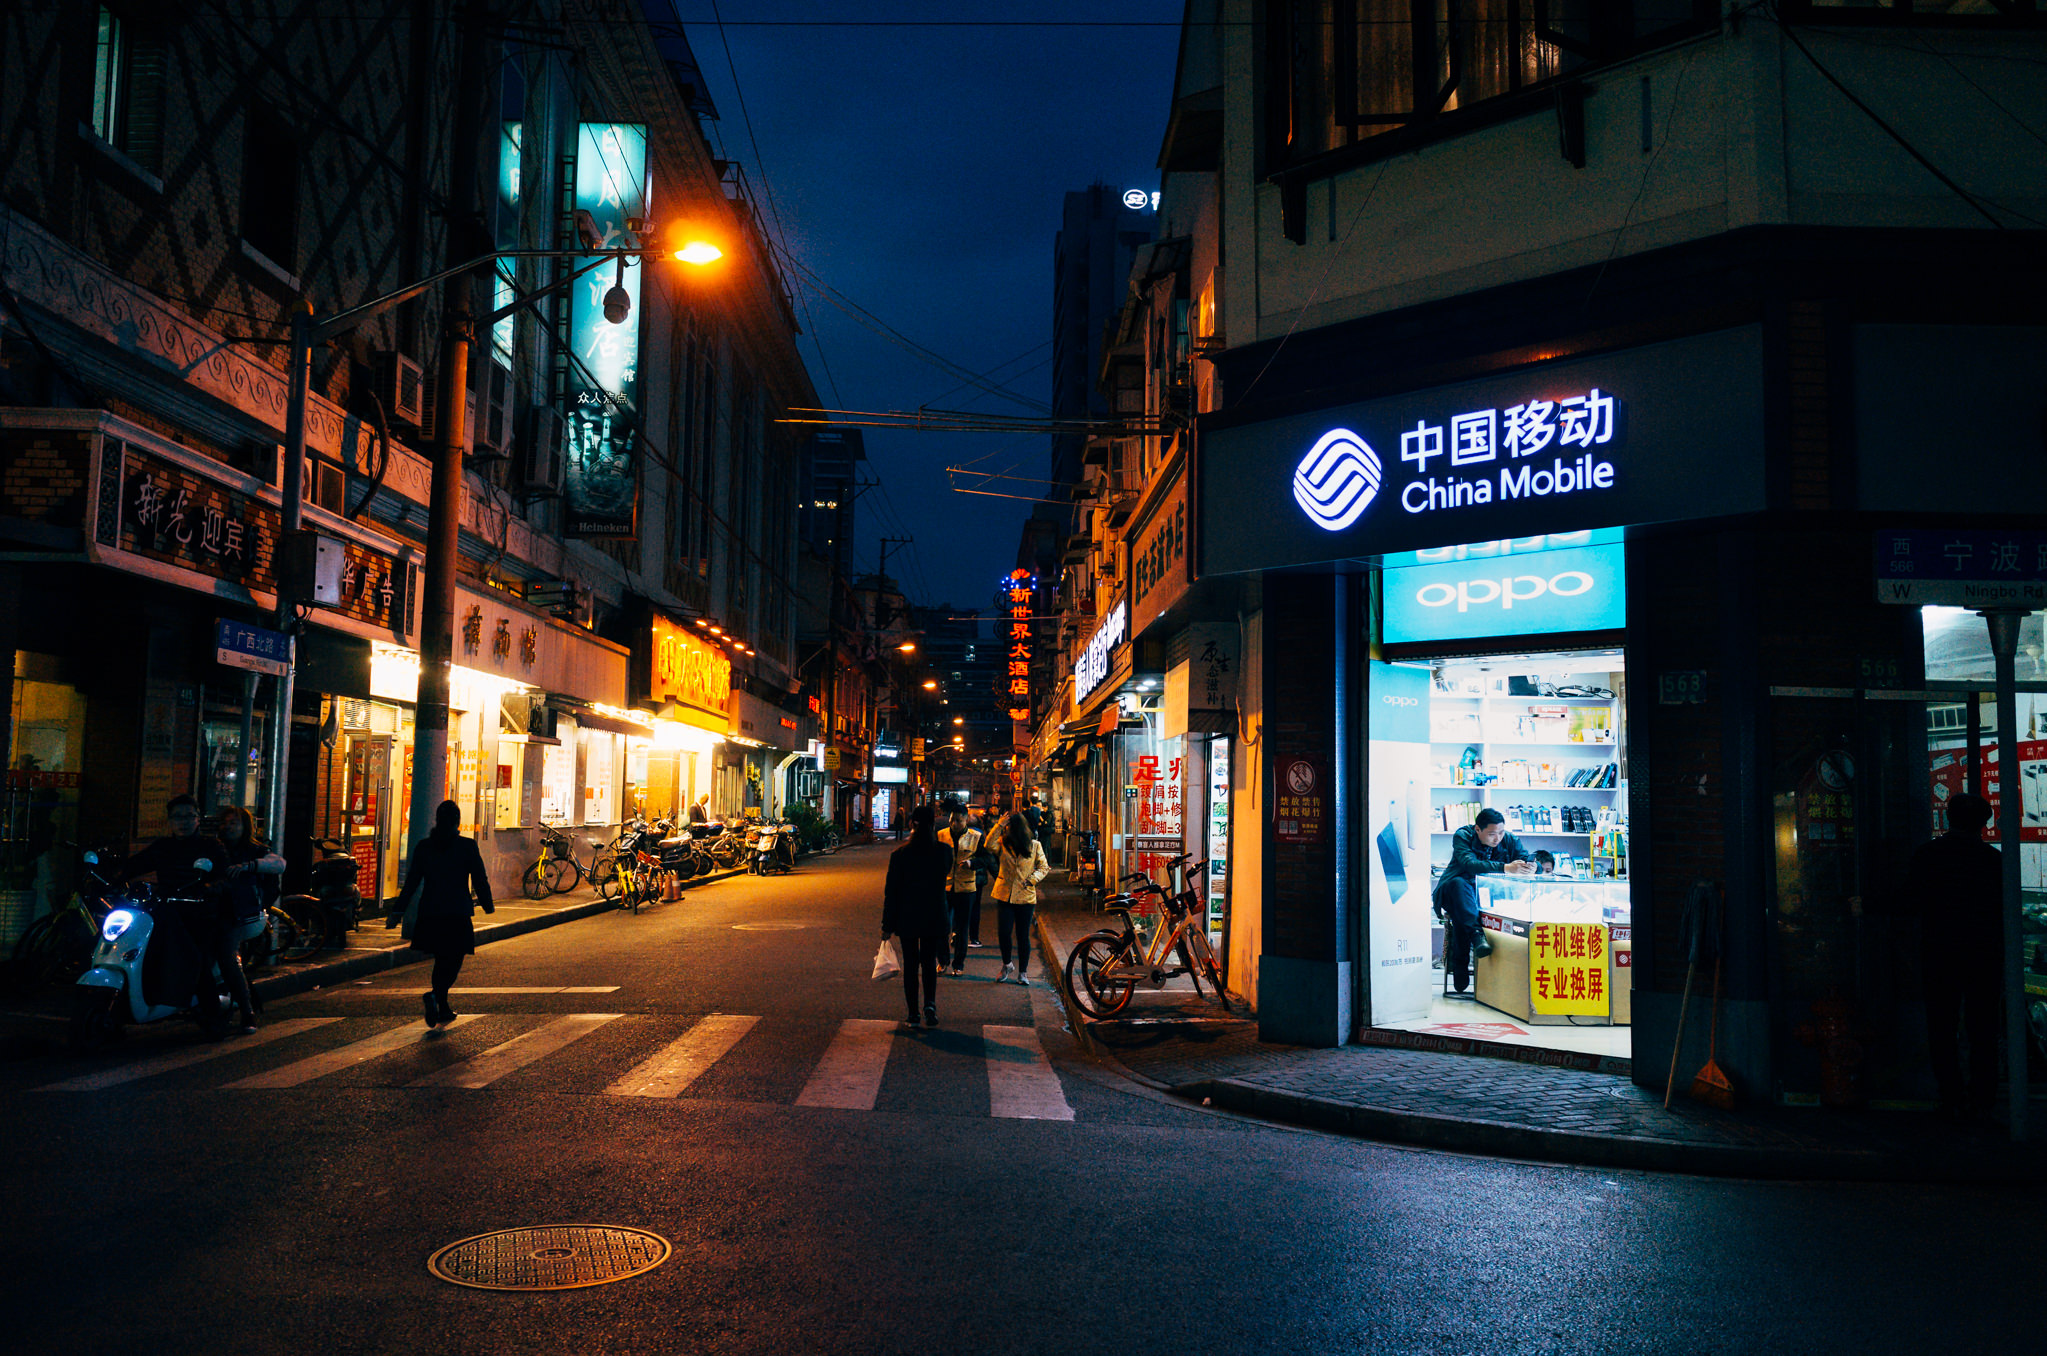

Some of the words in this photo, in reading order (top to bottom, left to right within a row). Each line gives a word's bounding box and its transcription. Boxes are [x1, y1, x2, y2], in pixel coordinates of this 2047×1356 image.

[577, 391, 629, 405] 众人焦点
[1400, 388, 1614, 473] 中国移动
[1401, 477, 1492, 513] China
[1500, 453, 1614, 500] Mobile
[579, 522, 630, 533] Heineken
[1891, 537, 1912, 556] 西
[1889, 560, 1914, 573] 566
[1415, 570, 1595, 613] oppo
[1893, 583, 1911, 599] W
[1965, 585, 2017, 600] Ningbo
[2023, 585, 2044, 598] Rd
[236, 629, 274, 654] 广西北路
[1008, 587, 1033, 695] 新世界大酒店
[222, 651, 227, 661] S
[1860, 658, 1897, 678] 566
[1383, 695, 1418, 707] oppo
[1535, 925, 1603, 960] 手机维修
[1535, 966, 1603, 1001] 专业换屏
